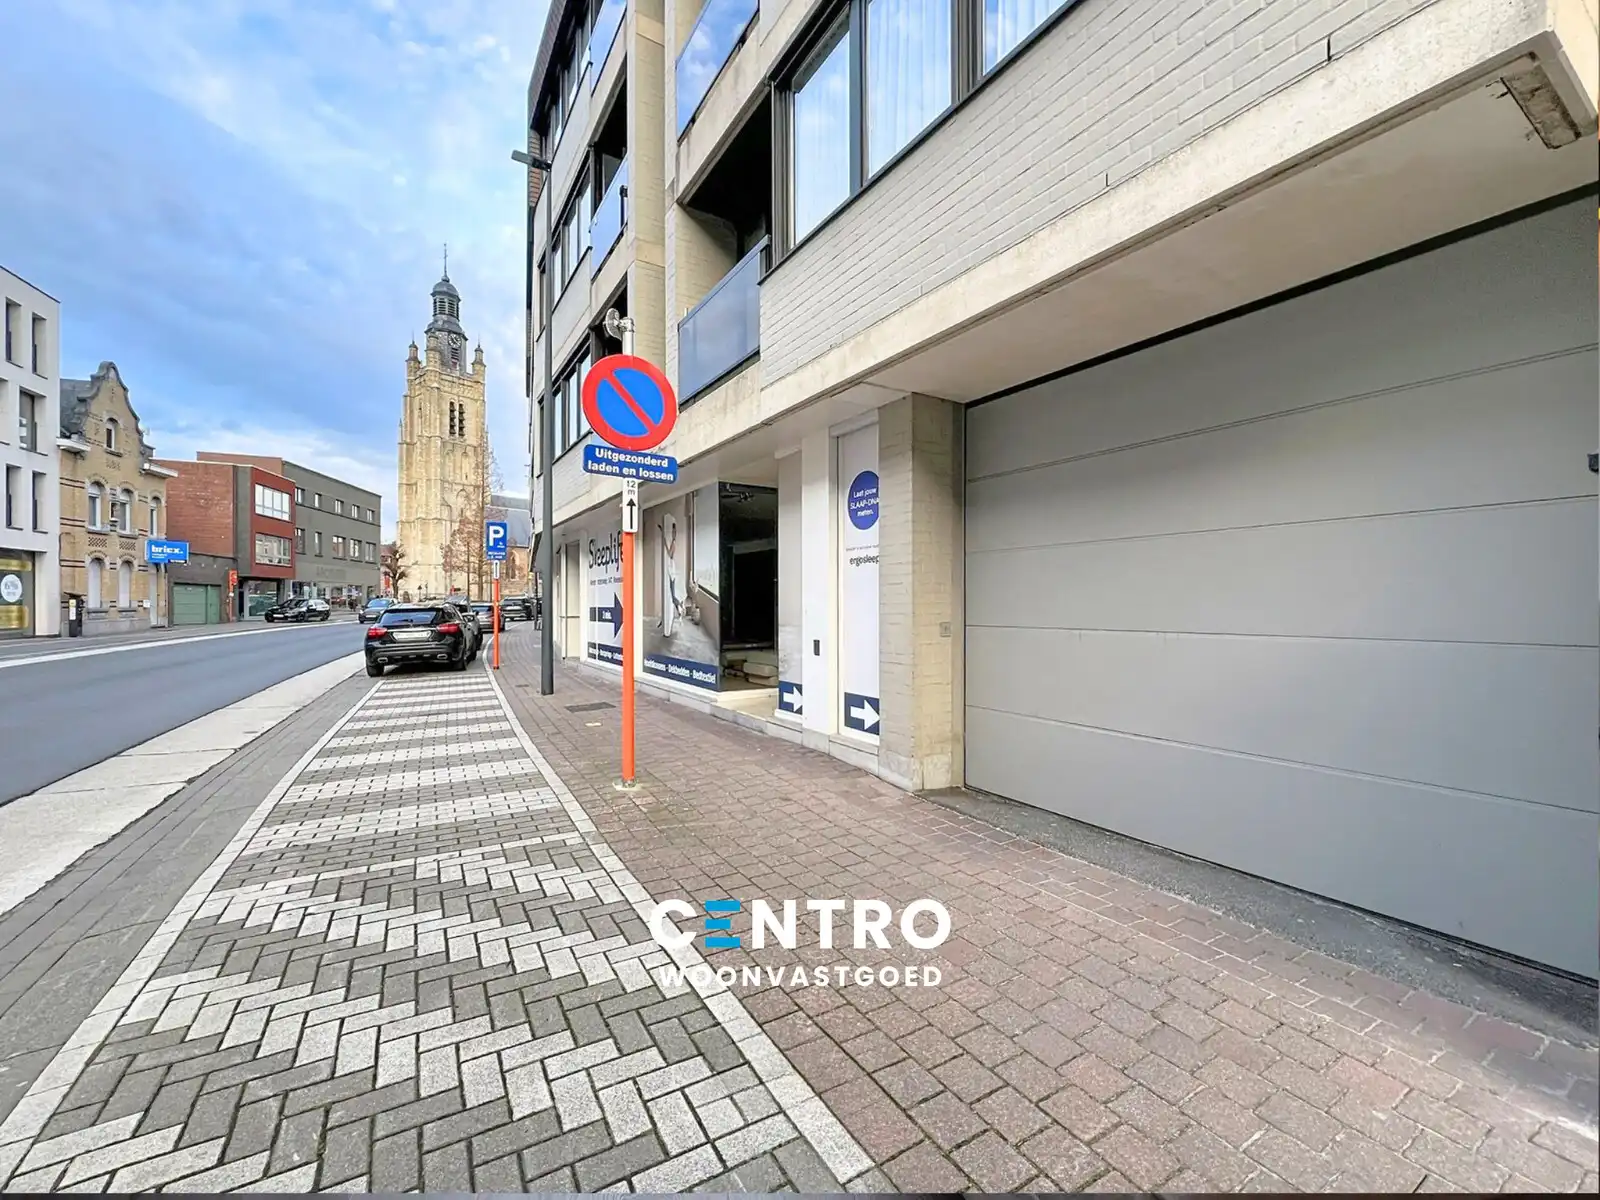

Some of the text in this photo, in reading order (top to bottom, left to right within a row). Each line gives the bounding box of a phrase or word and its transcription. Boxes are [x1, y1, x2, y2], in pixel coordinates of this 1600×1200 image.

[595, 447, 668, 468] Uitgezonderd
[588, 460, 674, 481] laden en lossen
[626, 480, 636, 488] 12
[489, 525, 504, 546] P
